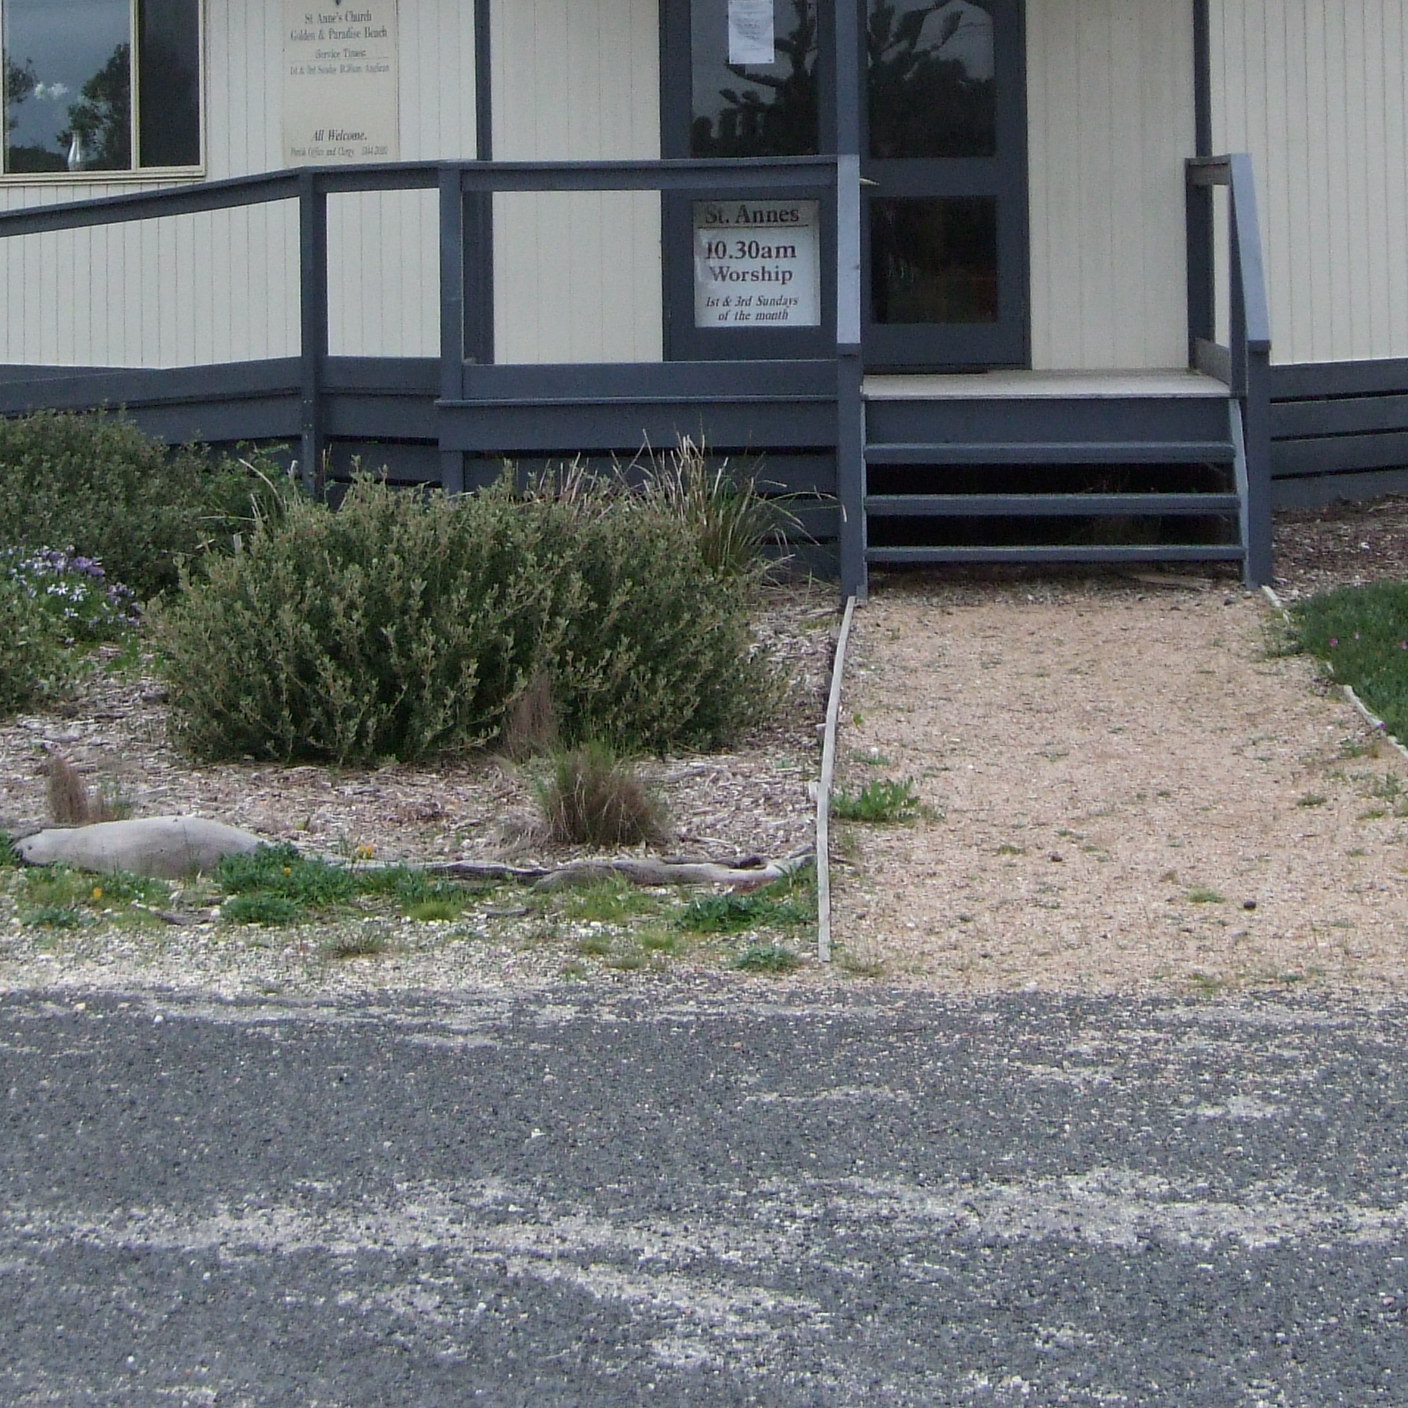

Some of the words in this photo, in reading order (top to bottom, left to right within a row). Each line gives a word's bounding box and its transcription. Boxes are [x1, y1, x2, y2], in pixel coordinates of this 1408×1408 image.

[304, 12, 313, 24] St
[317, 12, 343, 24] Anne's
[345, 9, 372, 22] Church
[290, 29, 315, 41] Golden
[318, 29, 325, 40] &
[328, 26, 361, 40] Paradise
[364, 25, 388, 38] Beach
[310, 128, 324, 142] All
[327, 128, 367, 142] Welcome.
[705, 205, 729, 224] St.
[735, 204, 800, 224] Annes
[705, 240, 797, 260] 10.30am
[709, 265, 793, 285] Worship
[706, 296, 719, 307] 1st
[722, 296, 732, 306] &
[734, 295, 753, 306] 3rd
[756, 294, 799, 308] Sundays
[718, 309, 731, 321] of
[734, 309, 751, 321] the
[755, 308, 789, 321] month
